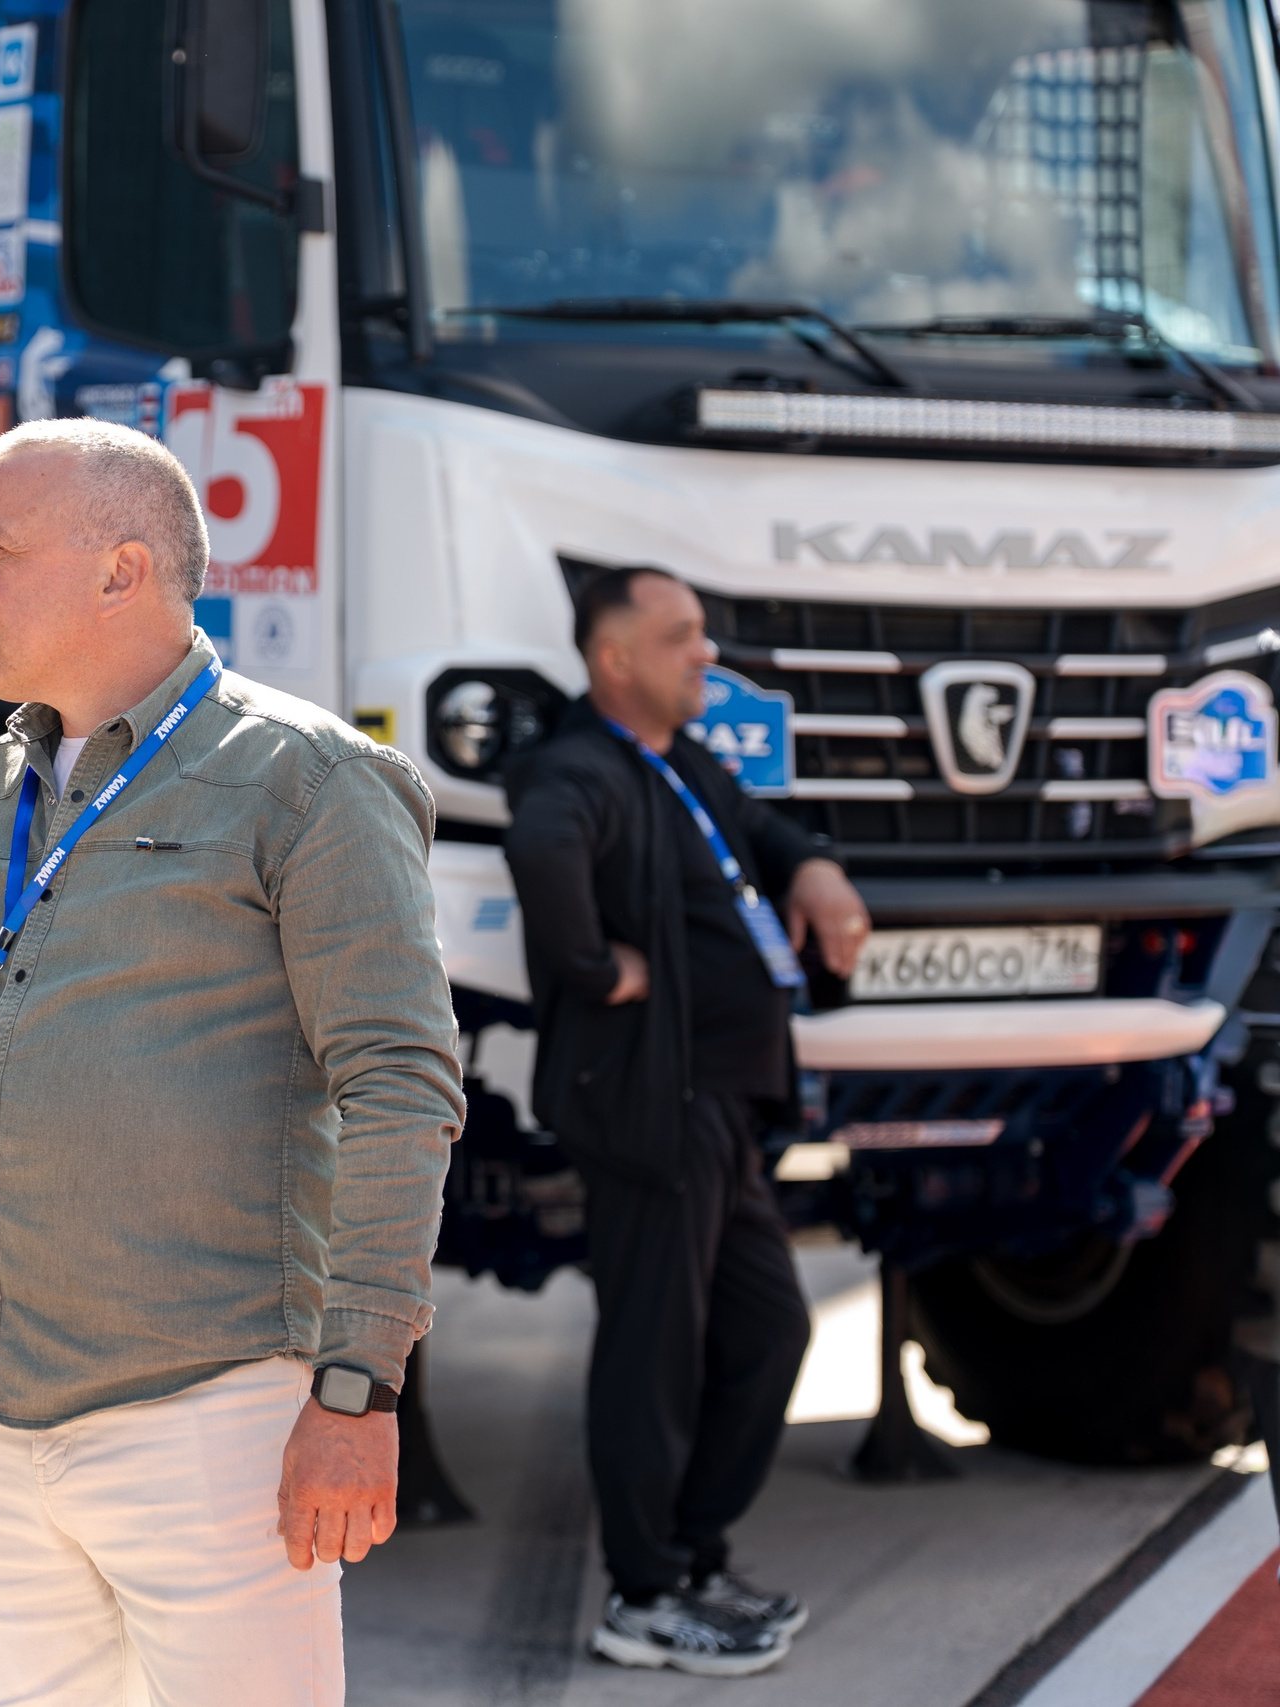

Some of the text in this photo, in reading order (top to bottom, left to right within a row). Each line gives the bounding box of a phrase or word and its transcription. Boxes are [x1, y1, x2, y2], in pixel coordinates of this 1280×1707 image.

[771, 520, 1174, 573] KAMAZ
[154, 703, 188, 741] KAMAZ
[92, 774, 127, 811] KAMAZ
[34, 847, 66, 887] KAMAZ
